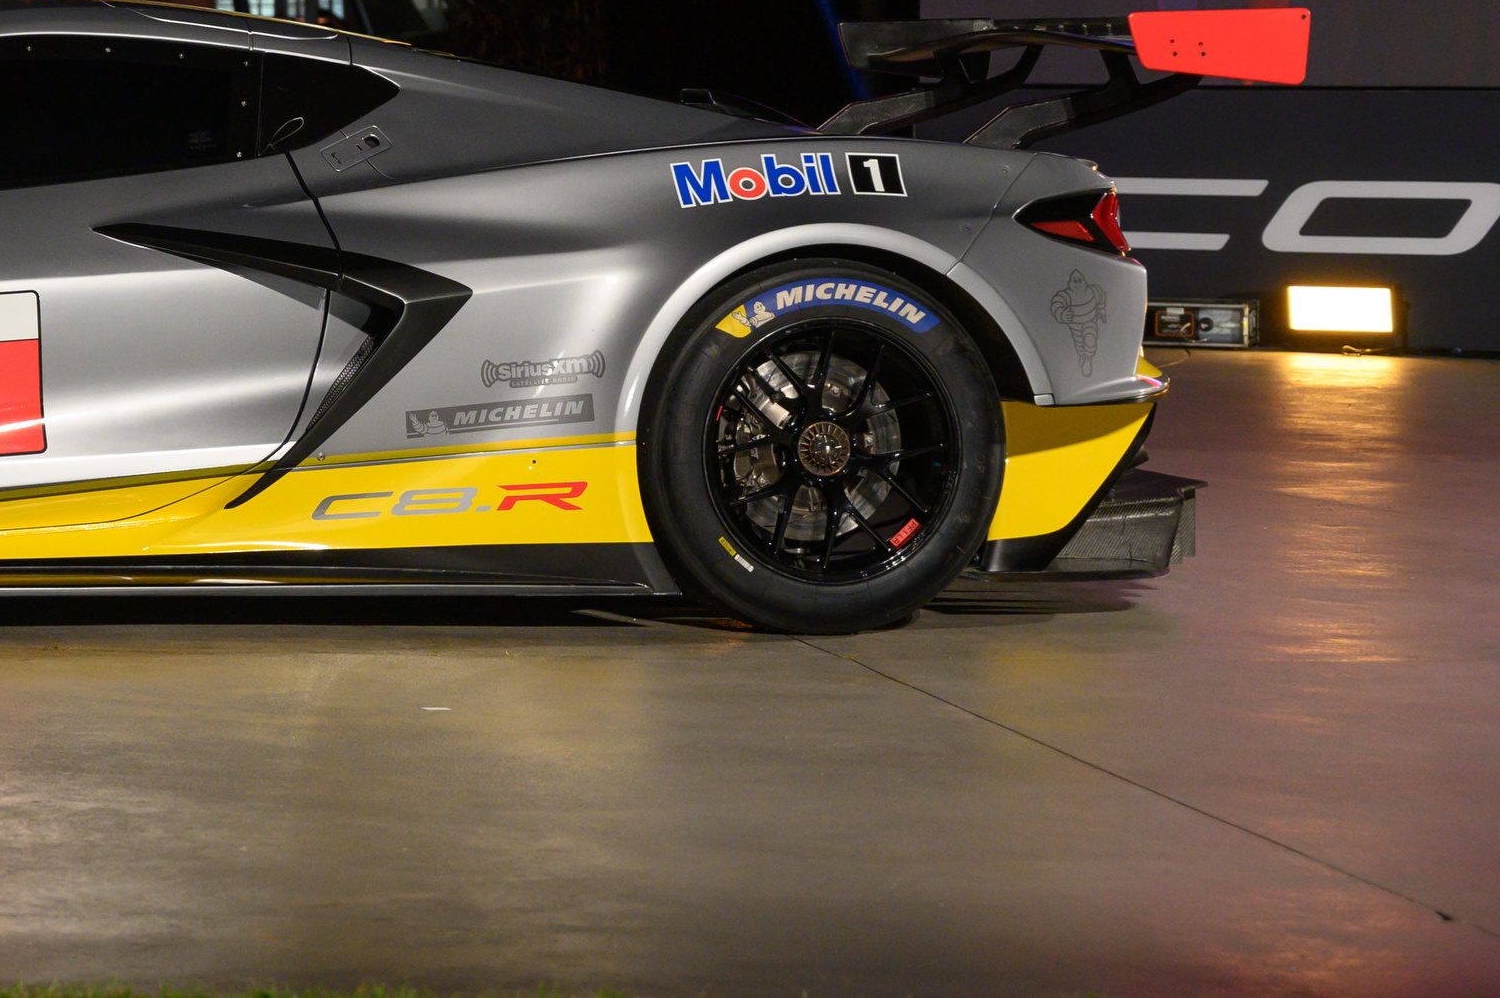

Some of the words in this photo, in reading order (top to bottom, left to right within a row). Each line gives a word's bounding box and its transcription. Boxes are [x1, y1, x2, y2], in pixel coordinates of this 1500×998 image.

[670, 153, 841, 208] Mobil
[863, 159, 885, 192] 1
[776, 282, 927, 324] MICHELIN
[453, 400, 584, 426] MICHELIN
[311, 481, 589, 521] C8.R
